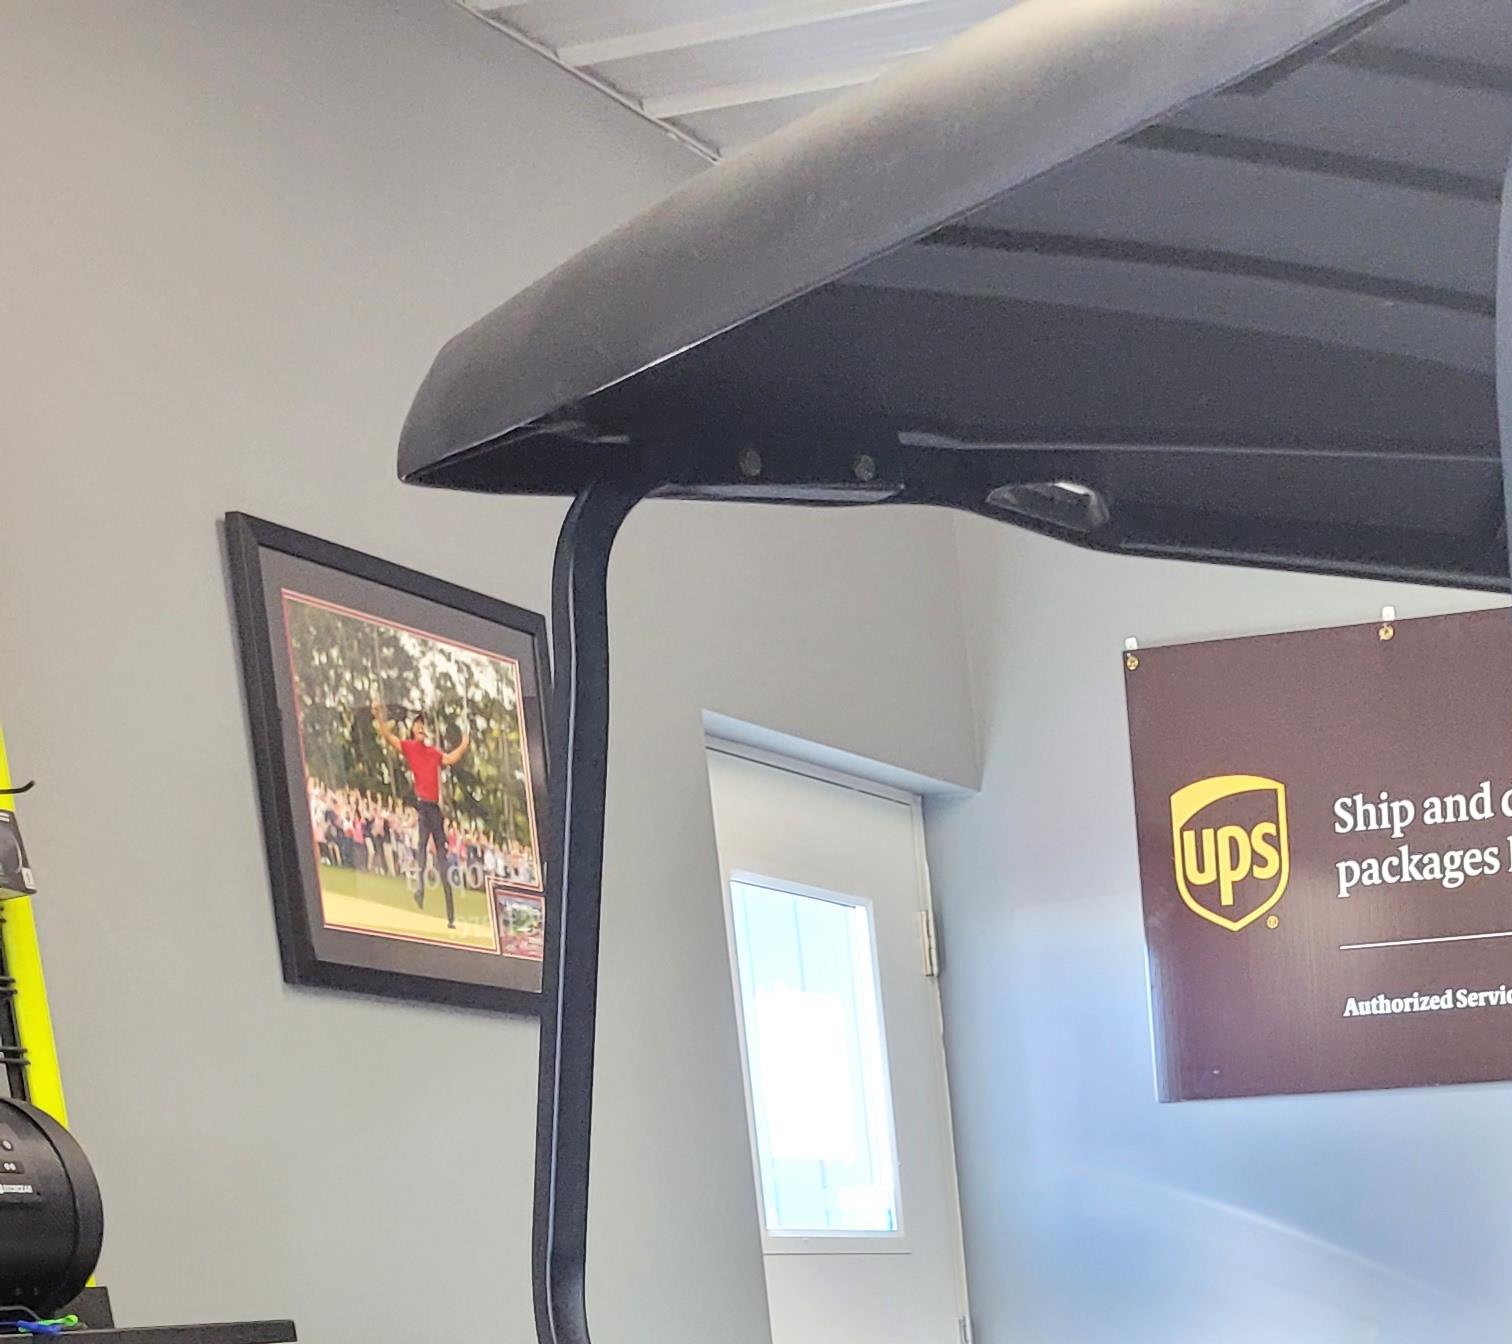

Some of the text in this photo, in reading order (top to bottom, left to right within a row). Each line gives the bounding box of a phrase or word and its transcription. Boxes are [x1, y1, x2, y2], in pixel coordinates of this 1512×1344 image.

[1333, 791, 1415, 838] Ship
[1423, 781, 1494, 825] and
[1182, 821, 1280, 906] ups
[1336, 844, 1501, 898] packages
[1343, 989, 1454, 1017] Authorized
